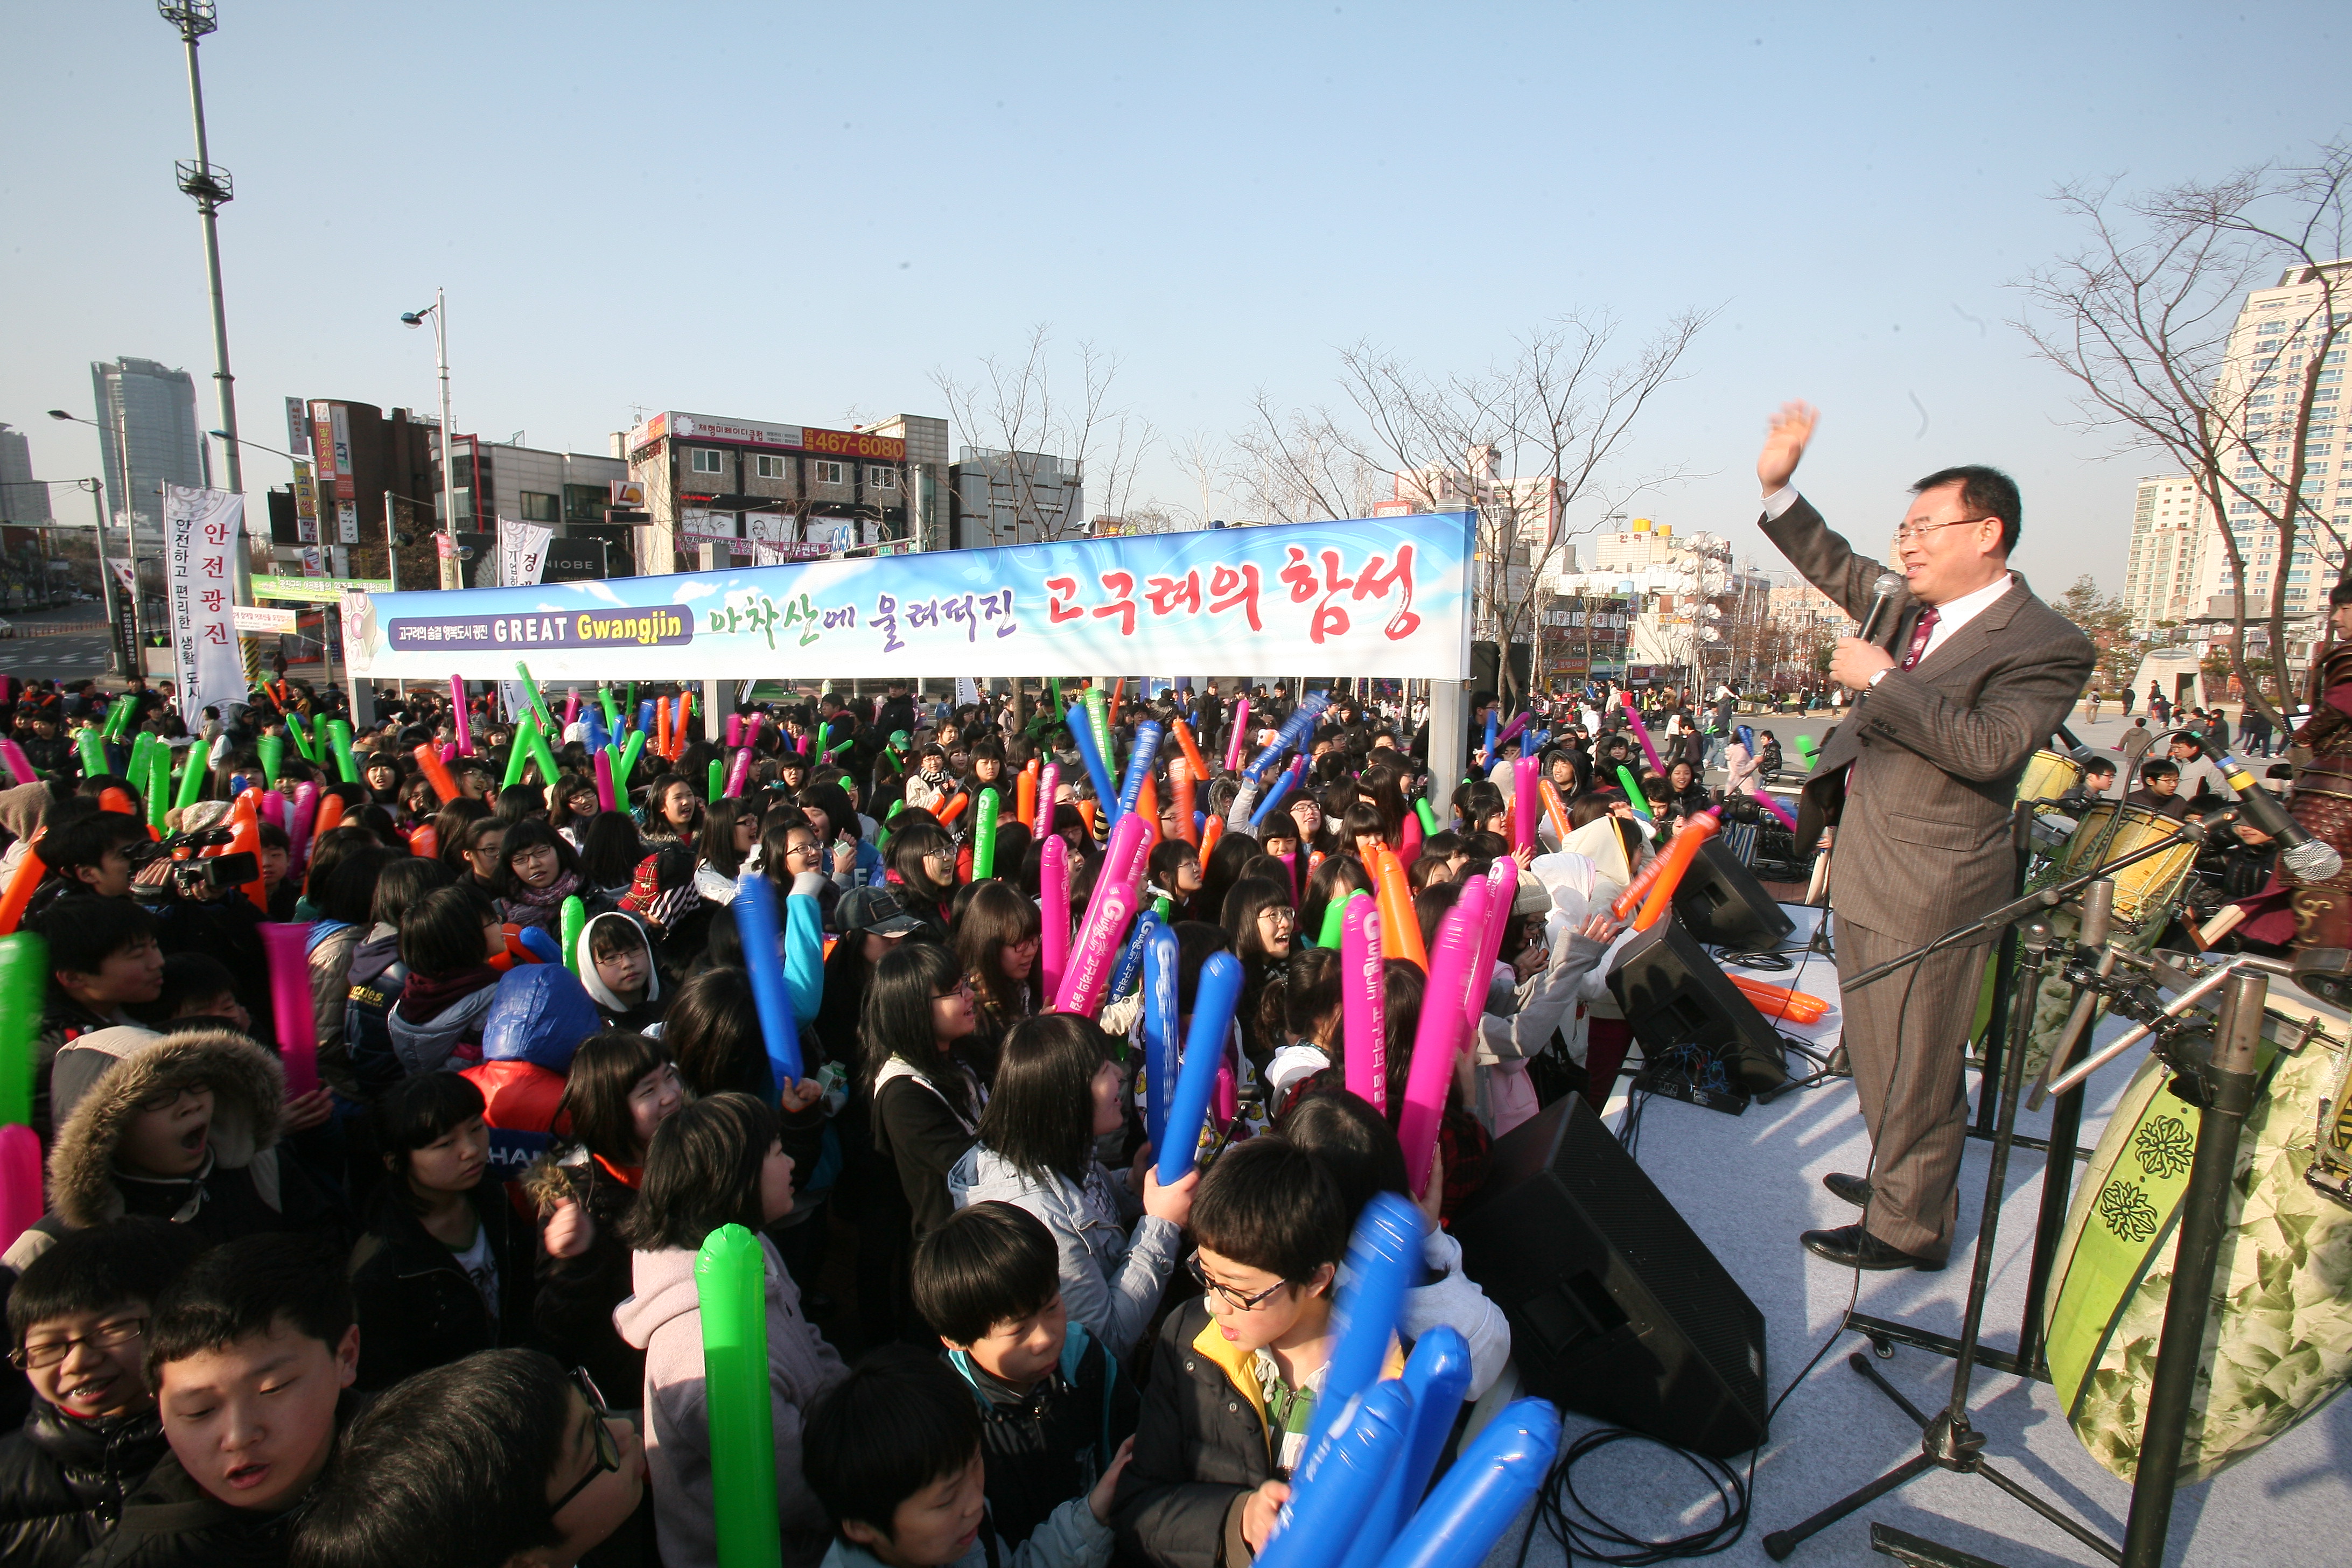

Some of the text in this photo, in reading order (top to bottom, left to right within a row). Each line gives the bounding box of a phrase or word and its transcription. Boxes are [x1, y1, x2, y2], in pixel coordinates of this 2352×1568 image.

[319, 427, 332, 470] 발맛사지
[335, 442, 349, 469] KTF
[816, 432, 904, 458] 467-6080
[174, 519, 200, 699] 안전하고 편리한 생활 도시
[200, 523, 230, 645] 안전광진
[1046, 545, 1421, 645] 고구려의 함성
[399, 625, 488, 641] 고구려의 숨결 행복도시 광진
[494, 611, 682, 645] GREAT Gwangjin
[710, 590, 1017, 653] 아차산에 울려퍼진
[1069, 955, 1100, 1012] 고구려의 숨결
[1116, 963, 1135, 993] 고구려의
[1371, 1006, 1385, 1068] 고구려의
